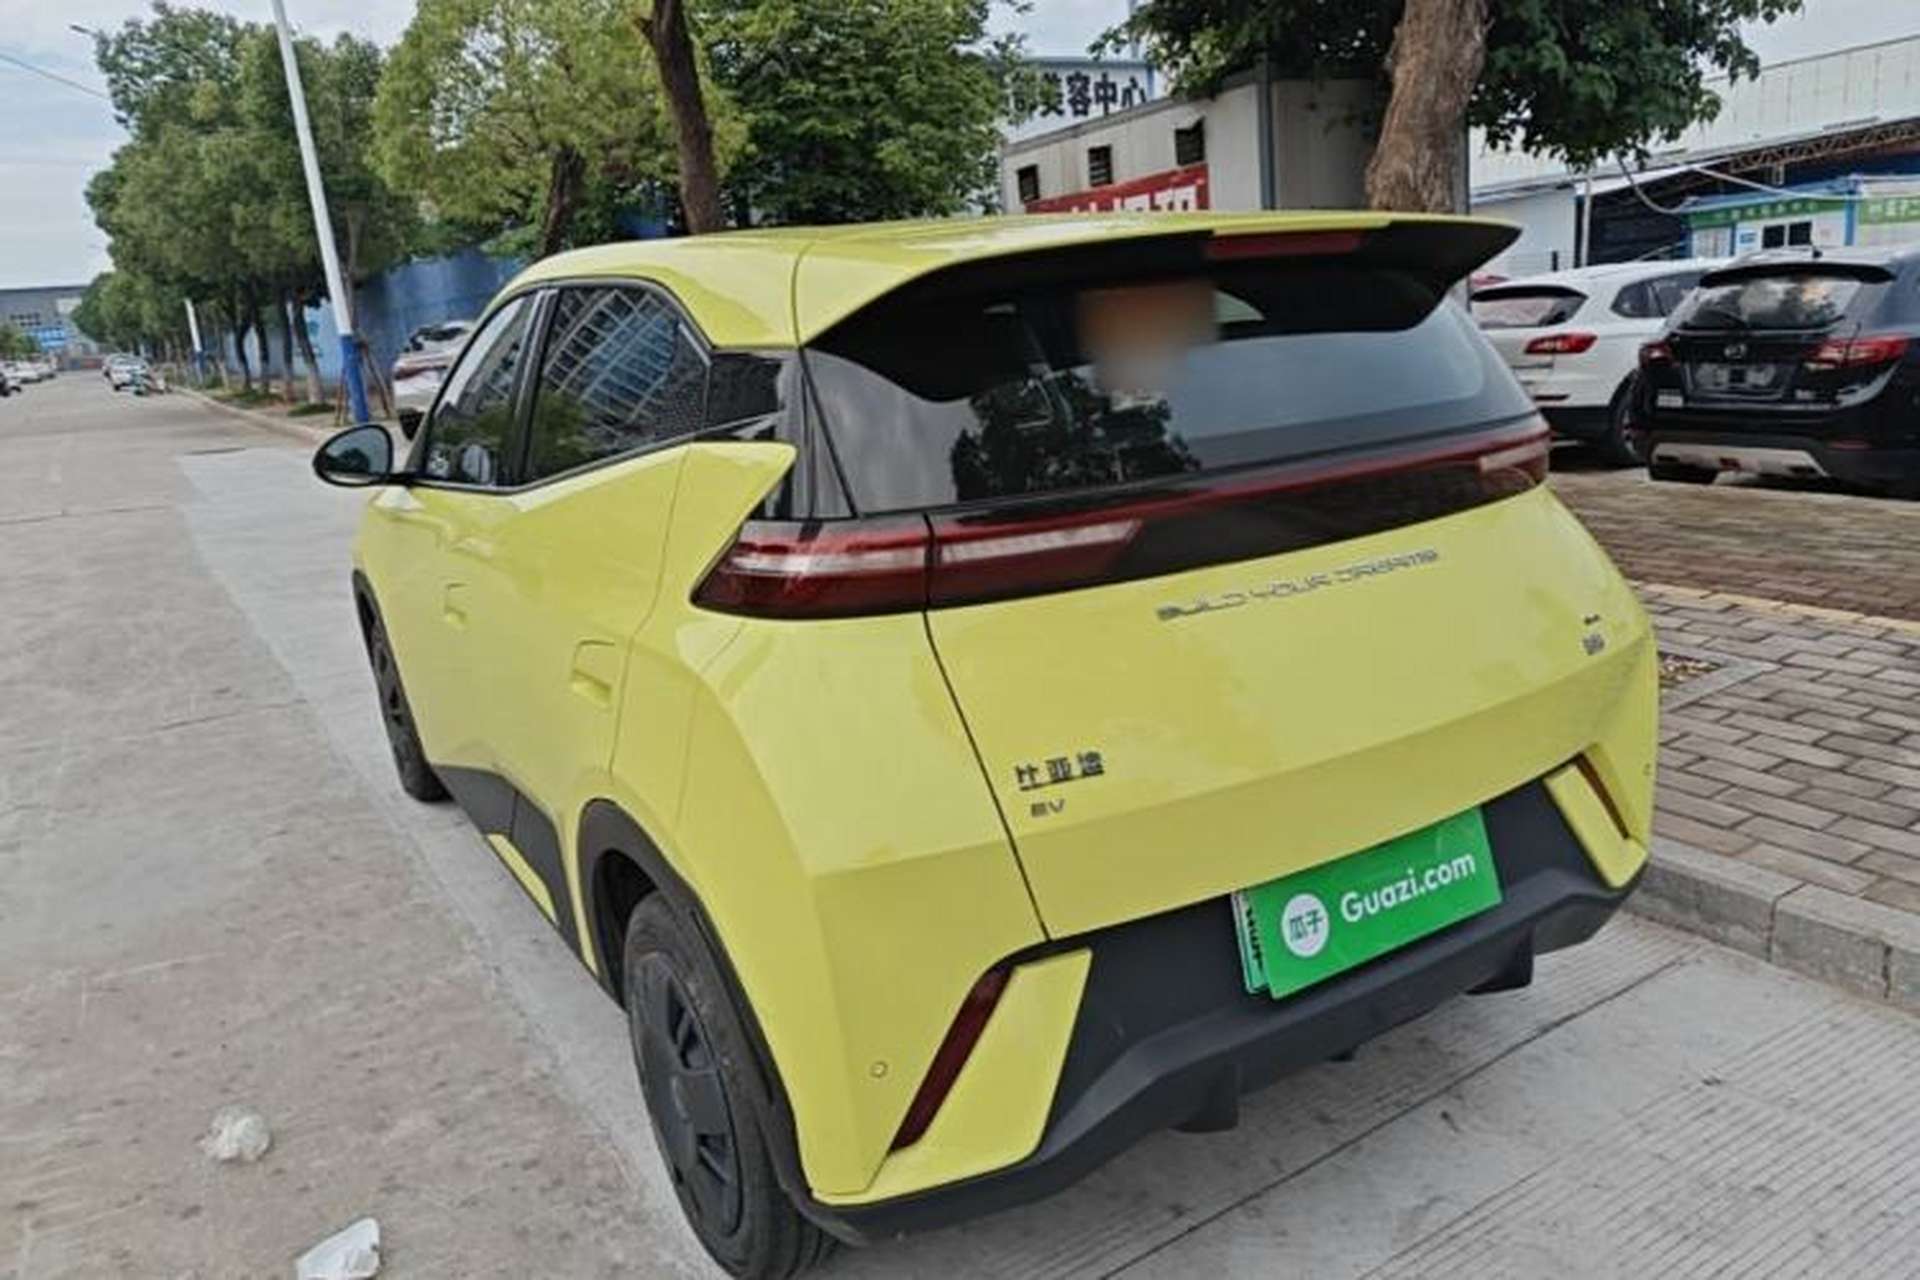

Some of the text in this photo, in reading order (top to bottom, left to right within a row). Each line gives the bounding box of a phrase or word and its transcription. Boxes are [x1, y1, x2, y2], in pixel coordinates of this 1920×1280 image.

[1249, 573, 1332, 600] YOUR
[1014, 751, 1105, 792] 比亚迪
[1030, 799, 1065, 818] EV
[1340, 853, 1476, 923] Guazi.com
[1289, 909, 1323, 941] 瓜子
